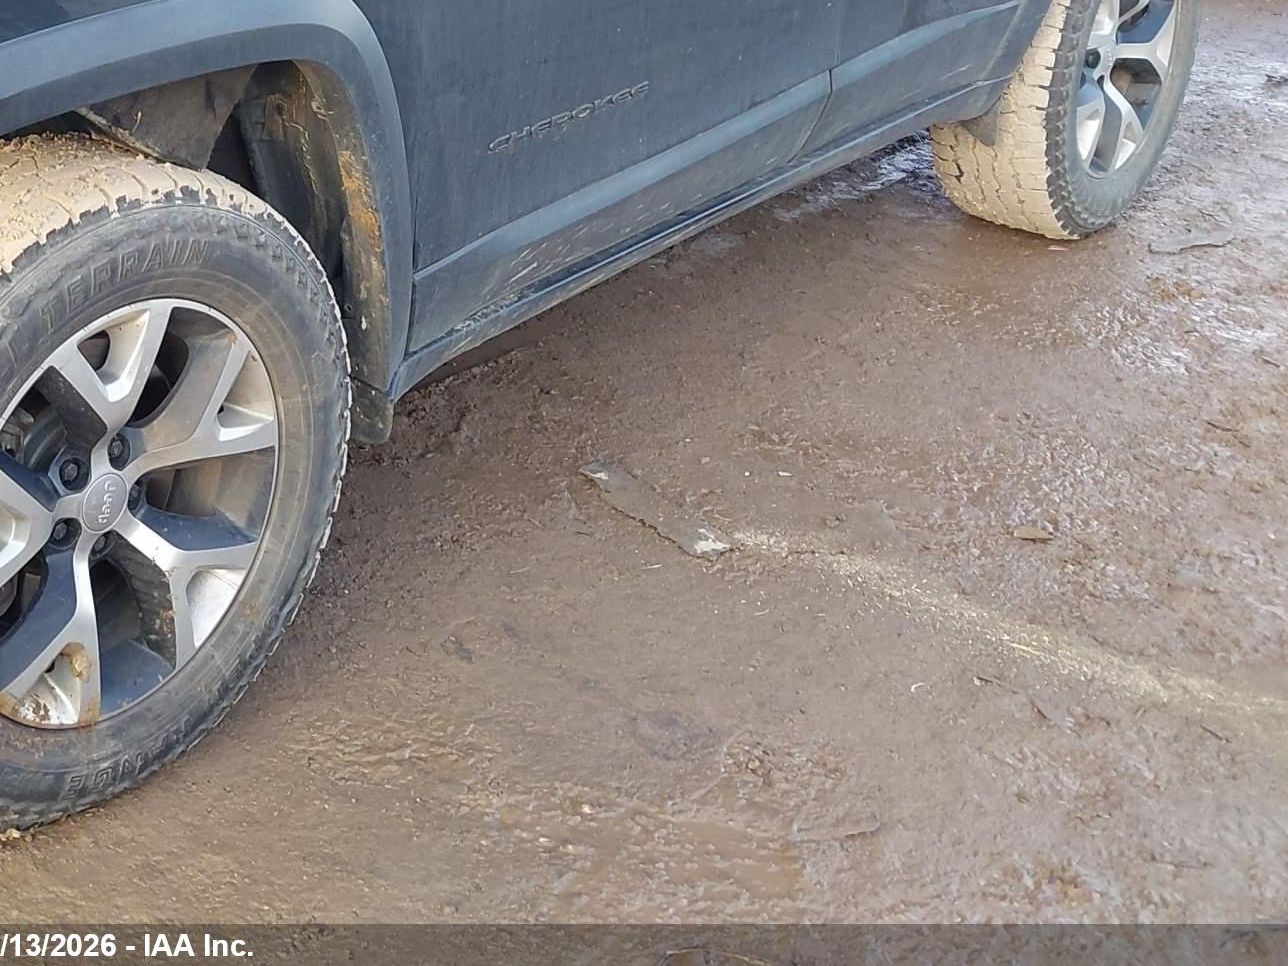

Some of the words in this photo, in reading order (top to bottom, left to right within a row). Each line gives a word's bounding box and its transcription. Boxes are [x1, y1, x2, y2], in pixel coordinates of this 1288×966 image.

[488, 81, 649, 154] CHEROKEE
[38, 237, 209, 334] TERRAIN
[97, 481, 117, 524] Jeep
